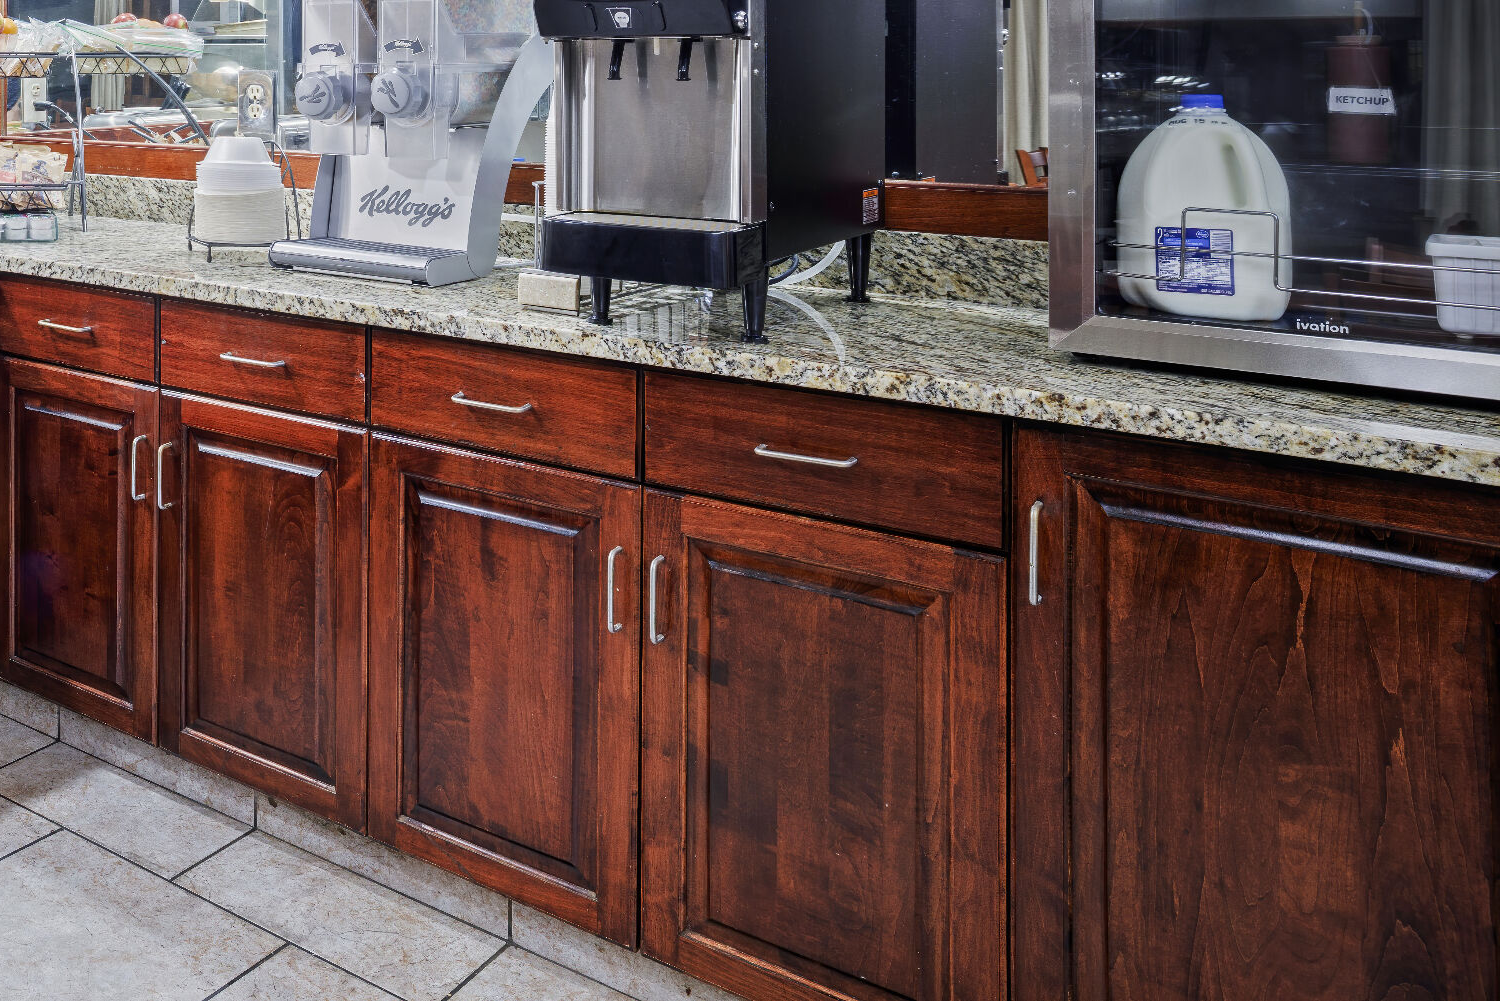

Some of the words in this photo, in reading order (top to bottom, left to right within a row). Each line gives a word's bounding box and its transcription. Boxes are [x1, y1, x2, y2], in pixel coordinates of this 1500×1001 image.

[1335, 95, 1389, 106] KETCHUP
[358, 184, 456, 228] Kellogg's
[1157, 227, 1164, 245] 2
[1296, 318, 1350, 335] ivation
